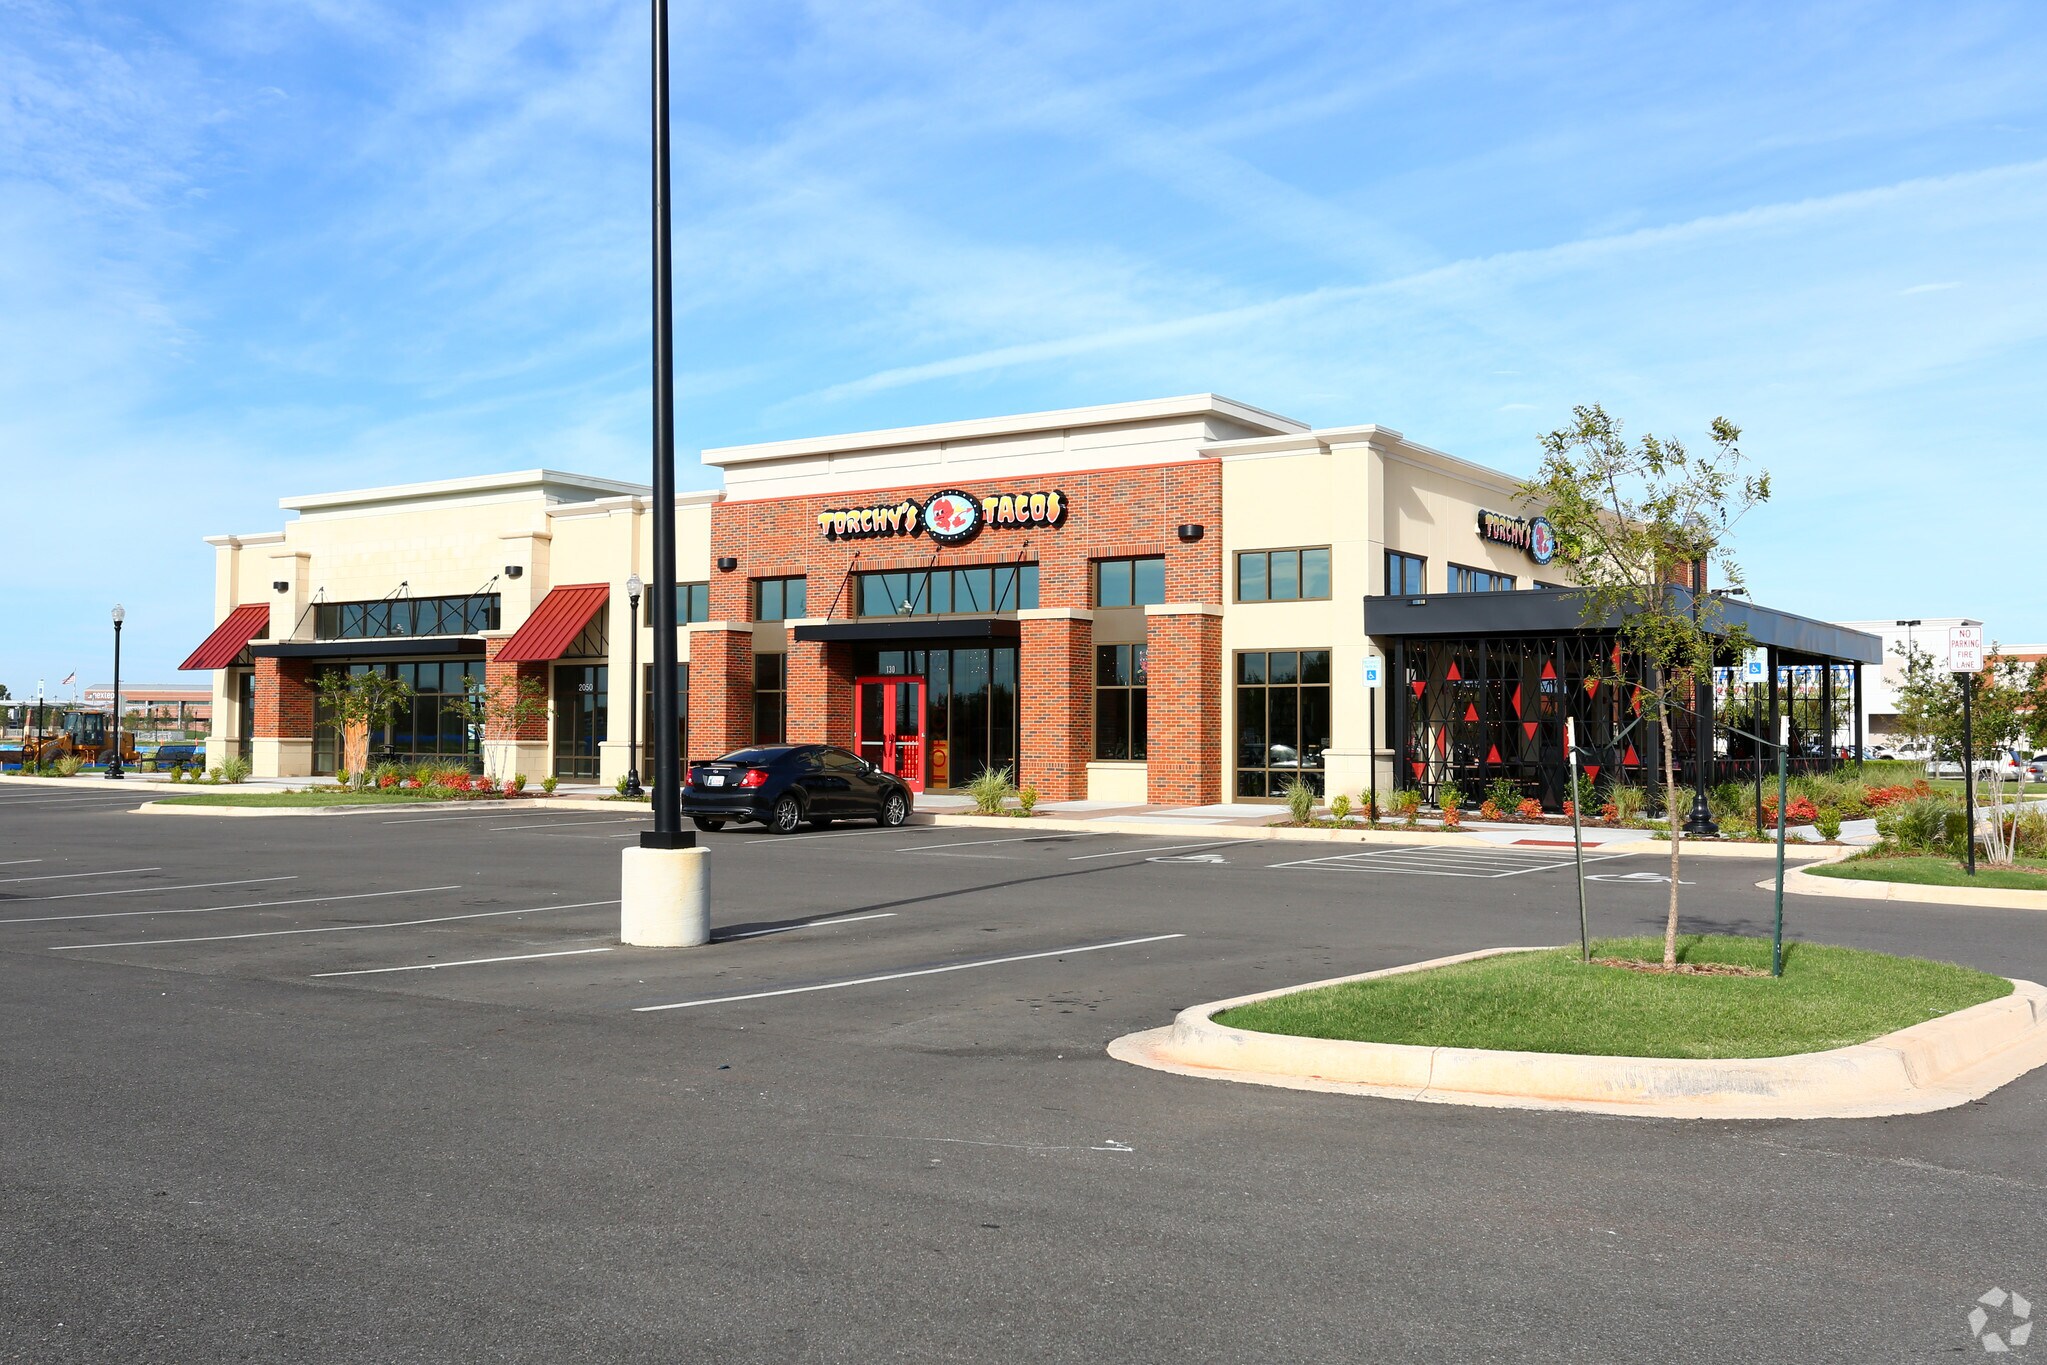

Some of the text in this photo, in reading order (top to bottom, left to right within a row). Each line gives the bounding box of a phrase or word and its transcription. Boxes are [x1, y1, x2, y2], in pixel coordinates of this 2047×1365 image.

[818, 492, 1060, 534] TORCHY'S TACOS
[1484, 512, 1532, 550] TORCHY'S
[1959, 629, 1971, 638] NO
[1951, 640, 1980, 648] PARKING
[886, 665, 896, 673] 130
[1956, 661, 1975, 669] LANE
